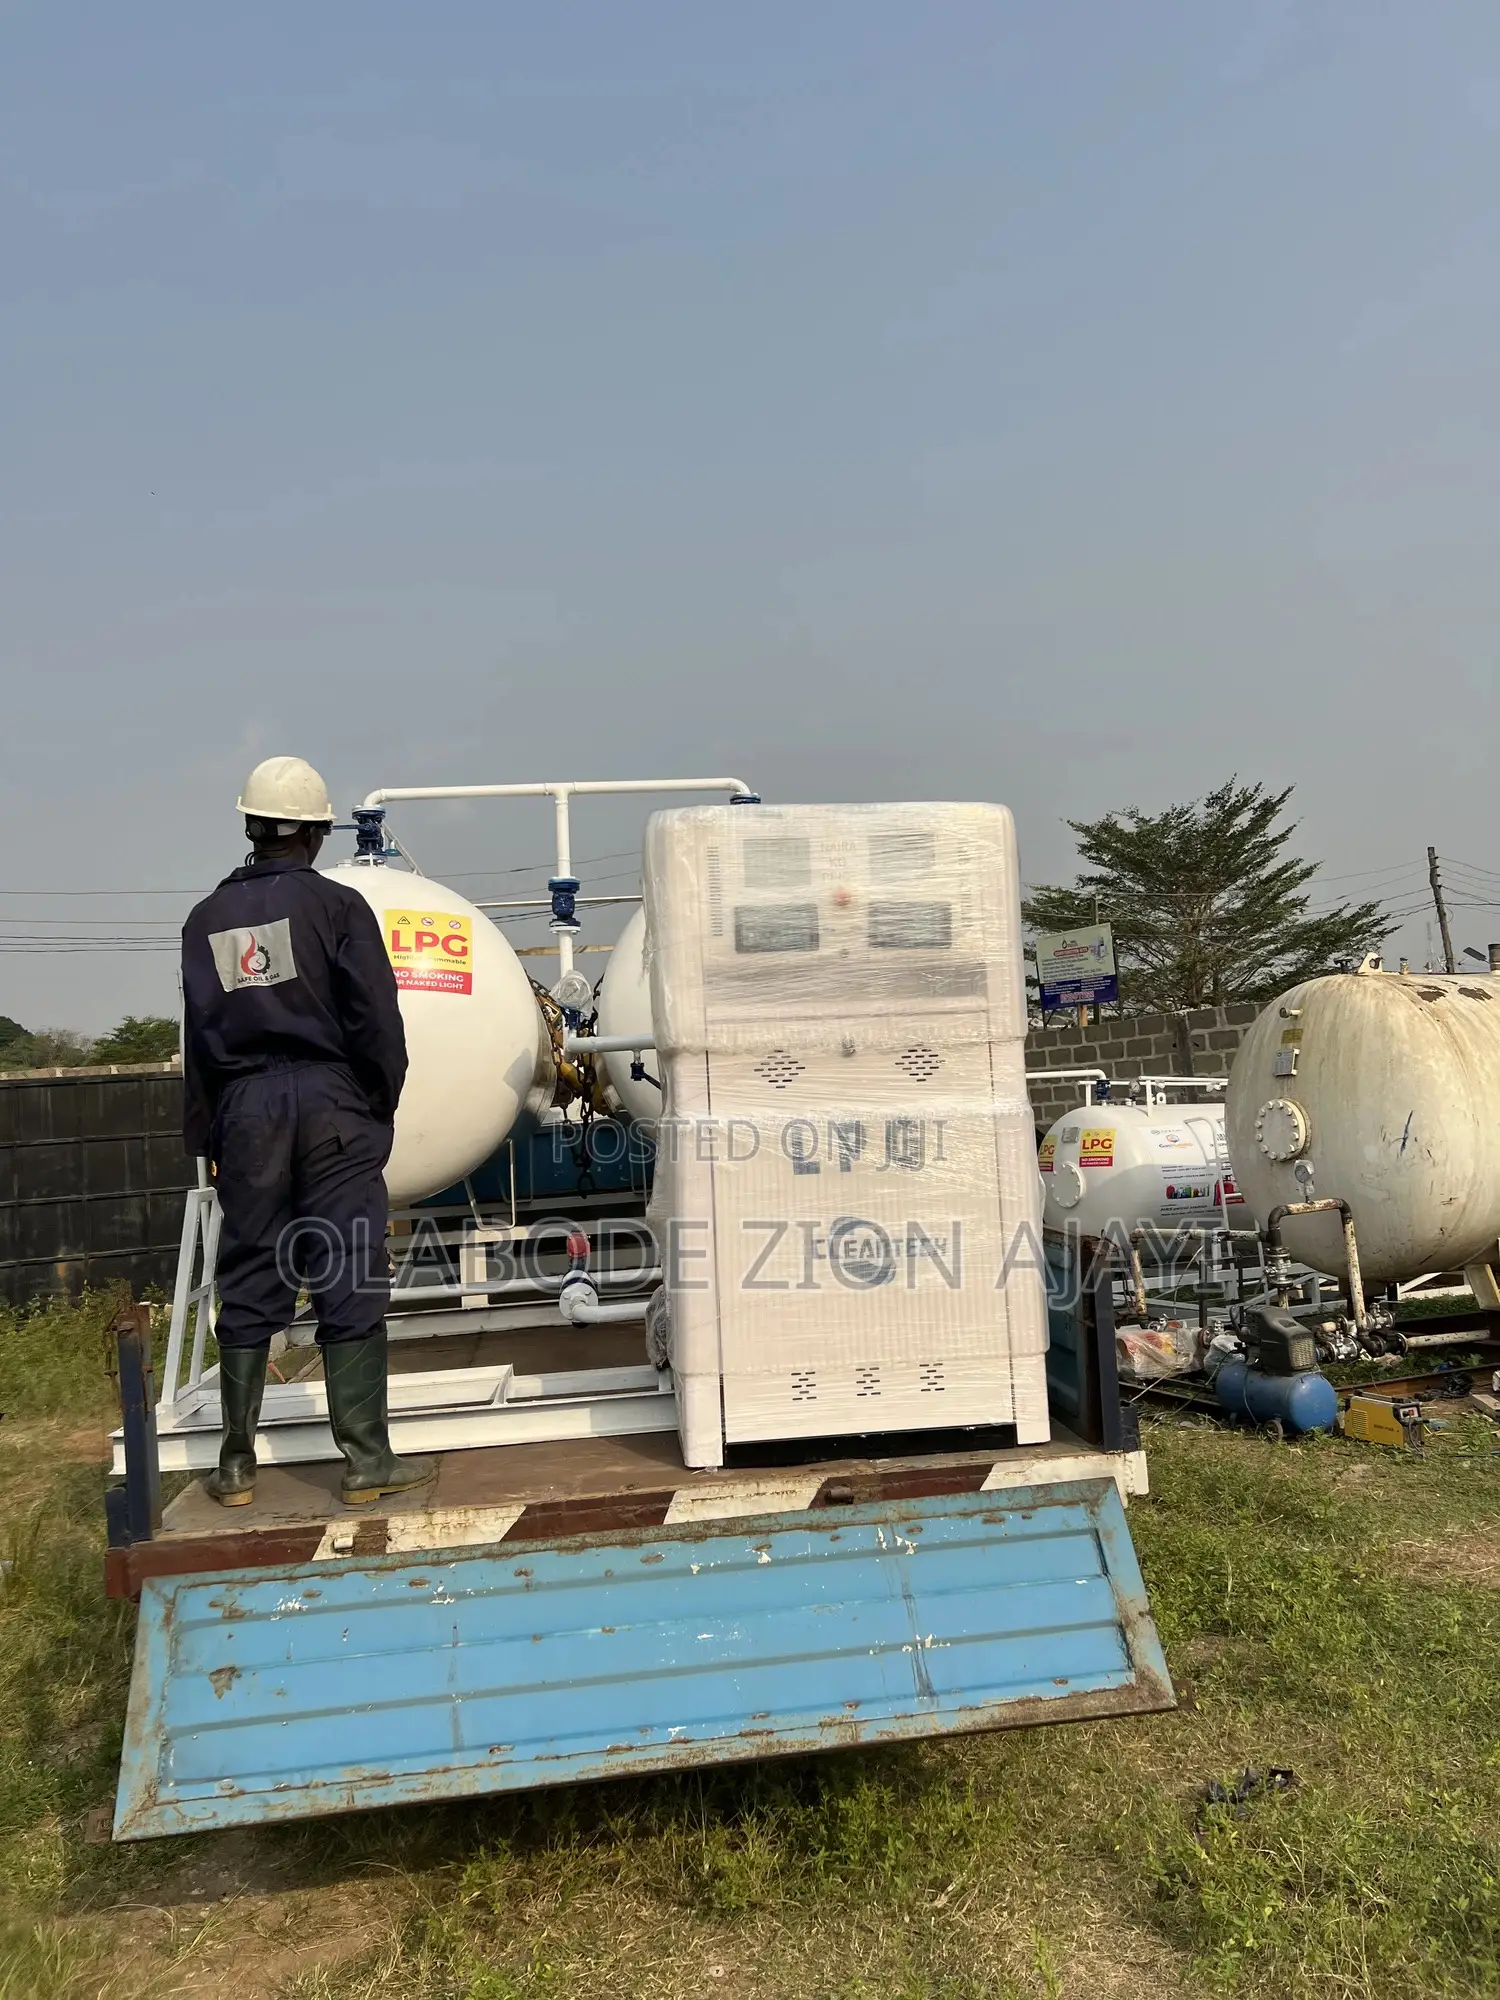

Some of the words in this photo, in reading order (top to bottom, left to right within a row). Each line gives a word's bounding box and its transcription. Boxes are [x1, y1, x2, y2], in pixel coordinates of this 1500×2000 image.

[391, 930, 468, 957] LPG
[270, 972, 280, 980] GAS
[411, 971, 464, 982] SMOKING
[406, 979, 438, 987] NAKED
[438, 982, 464, 990] LIGHT
[1082, 1138, 1113, 1151] LPG
